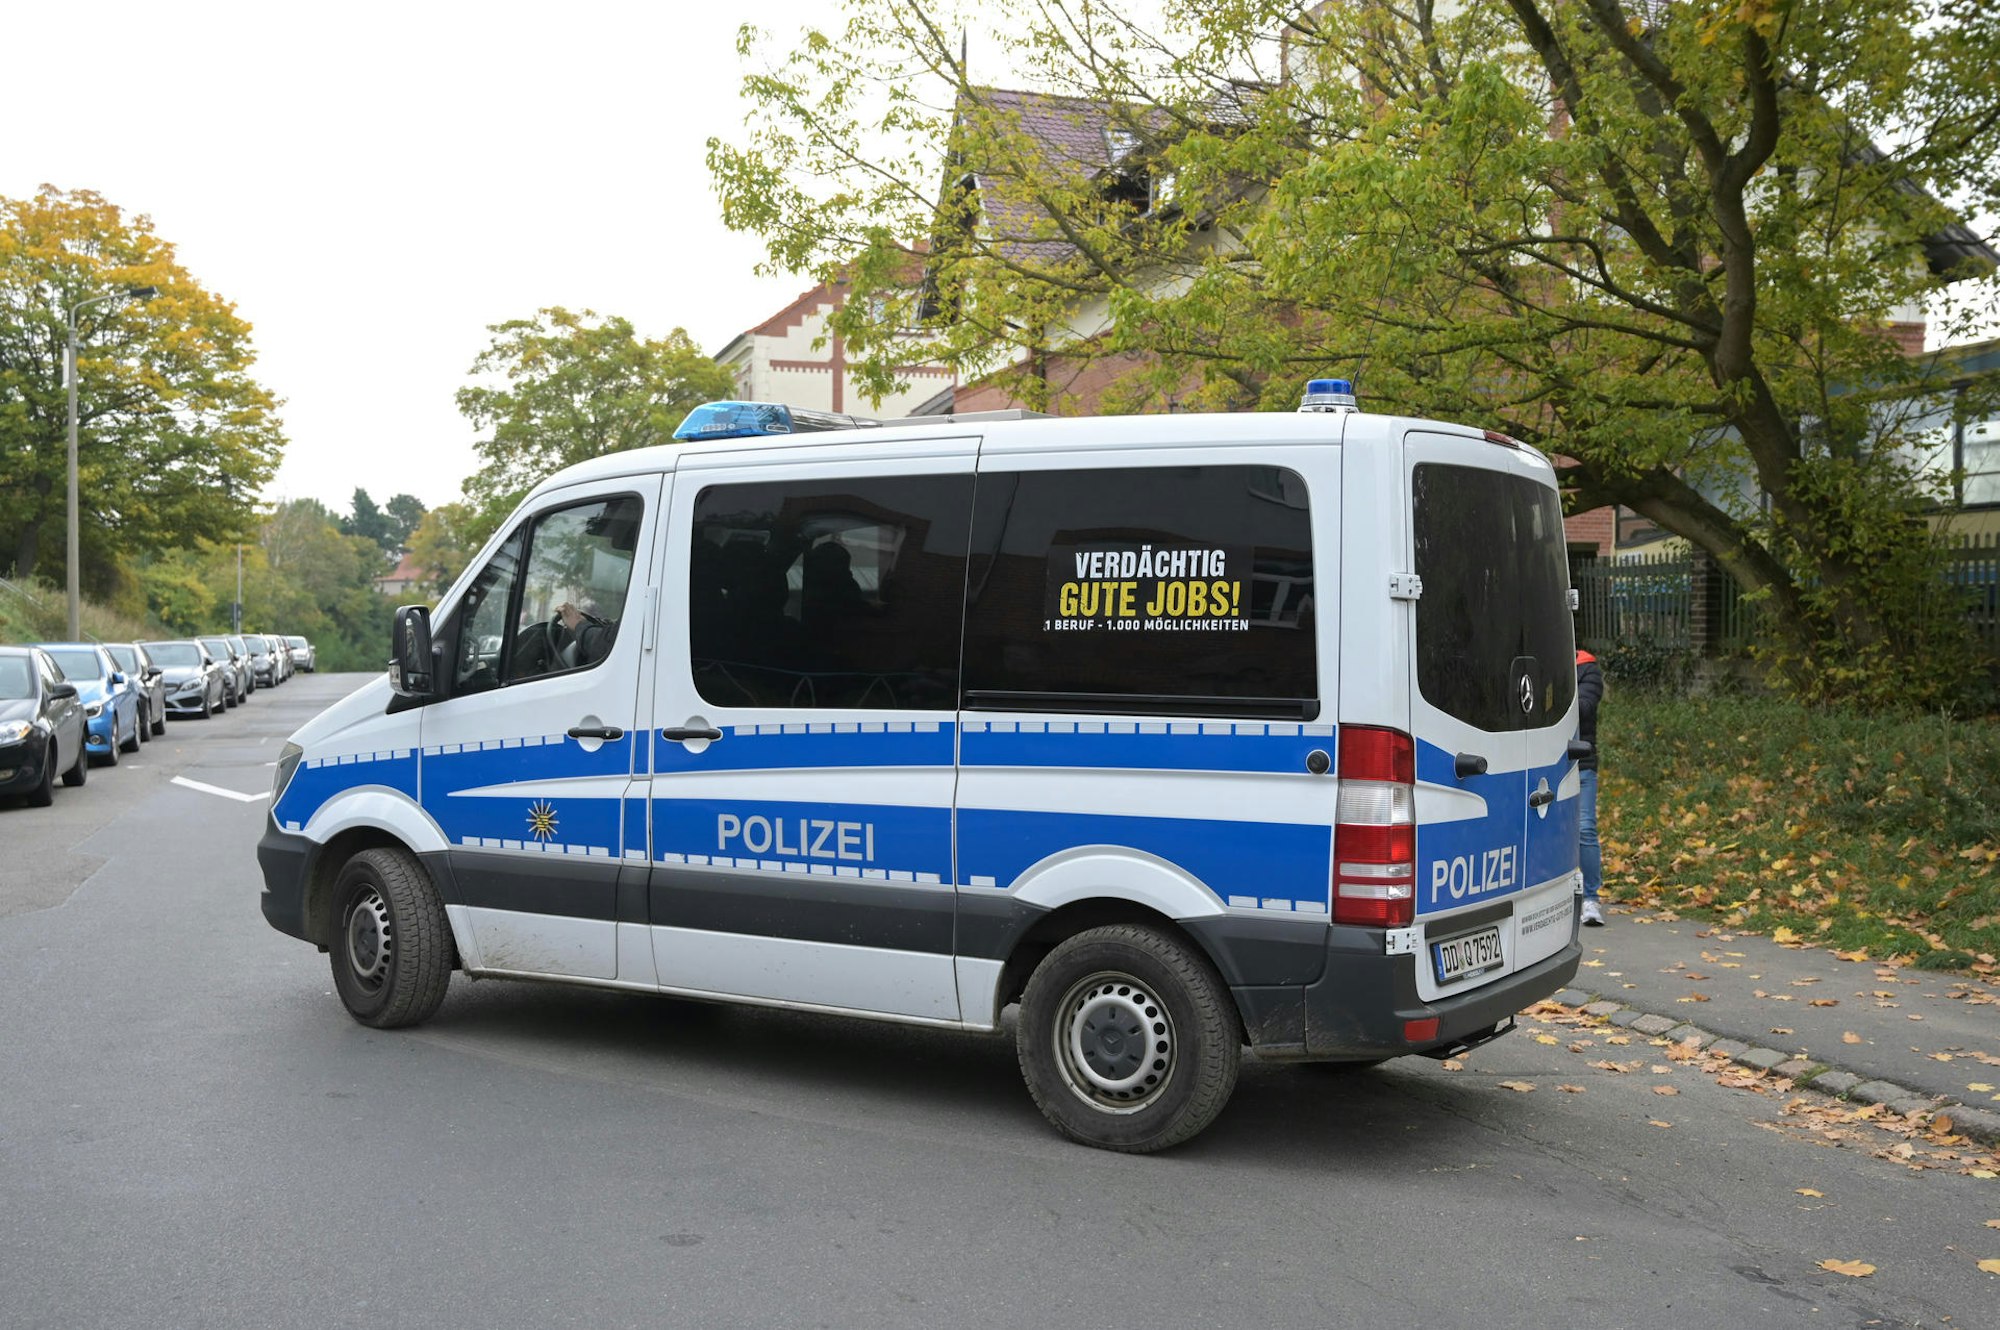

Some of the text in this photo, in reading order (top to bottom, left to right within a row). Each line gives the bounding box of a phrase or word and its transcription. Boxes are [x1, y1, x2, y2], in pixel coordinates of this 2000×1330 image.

[1075, 545, 1226, 579] VERDÄCHTIG
[1059, 580, 1241, 617] GUTE JOBS!
[1045, 619, 1050, 631] 1
[1054, 619, 1095, 631] BERUF
[1107, 619, 1140, 631] 1.000
[1144, 617, 1249, 631] MÖGLICHKEITEN
[717, 813, 875, 862] POLIZEI
[1431, 845, 1517, 903] POLIZEI
[1442, 945, 1459, 974] DD
[1464, 941, 1473, 967] Q
[1473, 933, 1500, 964] 7592
